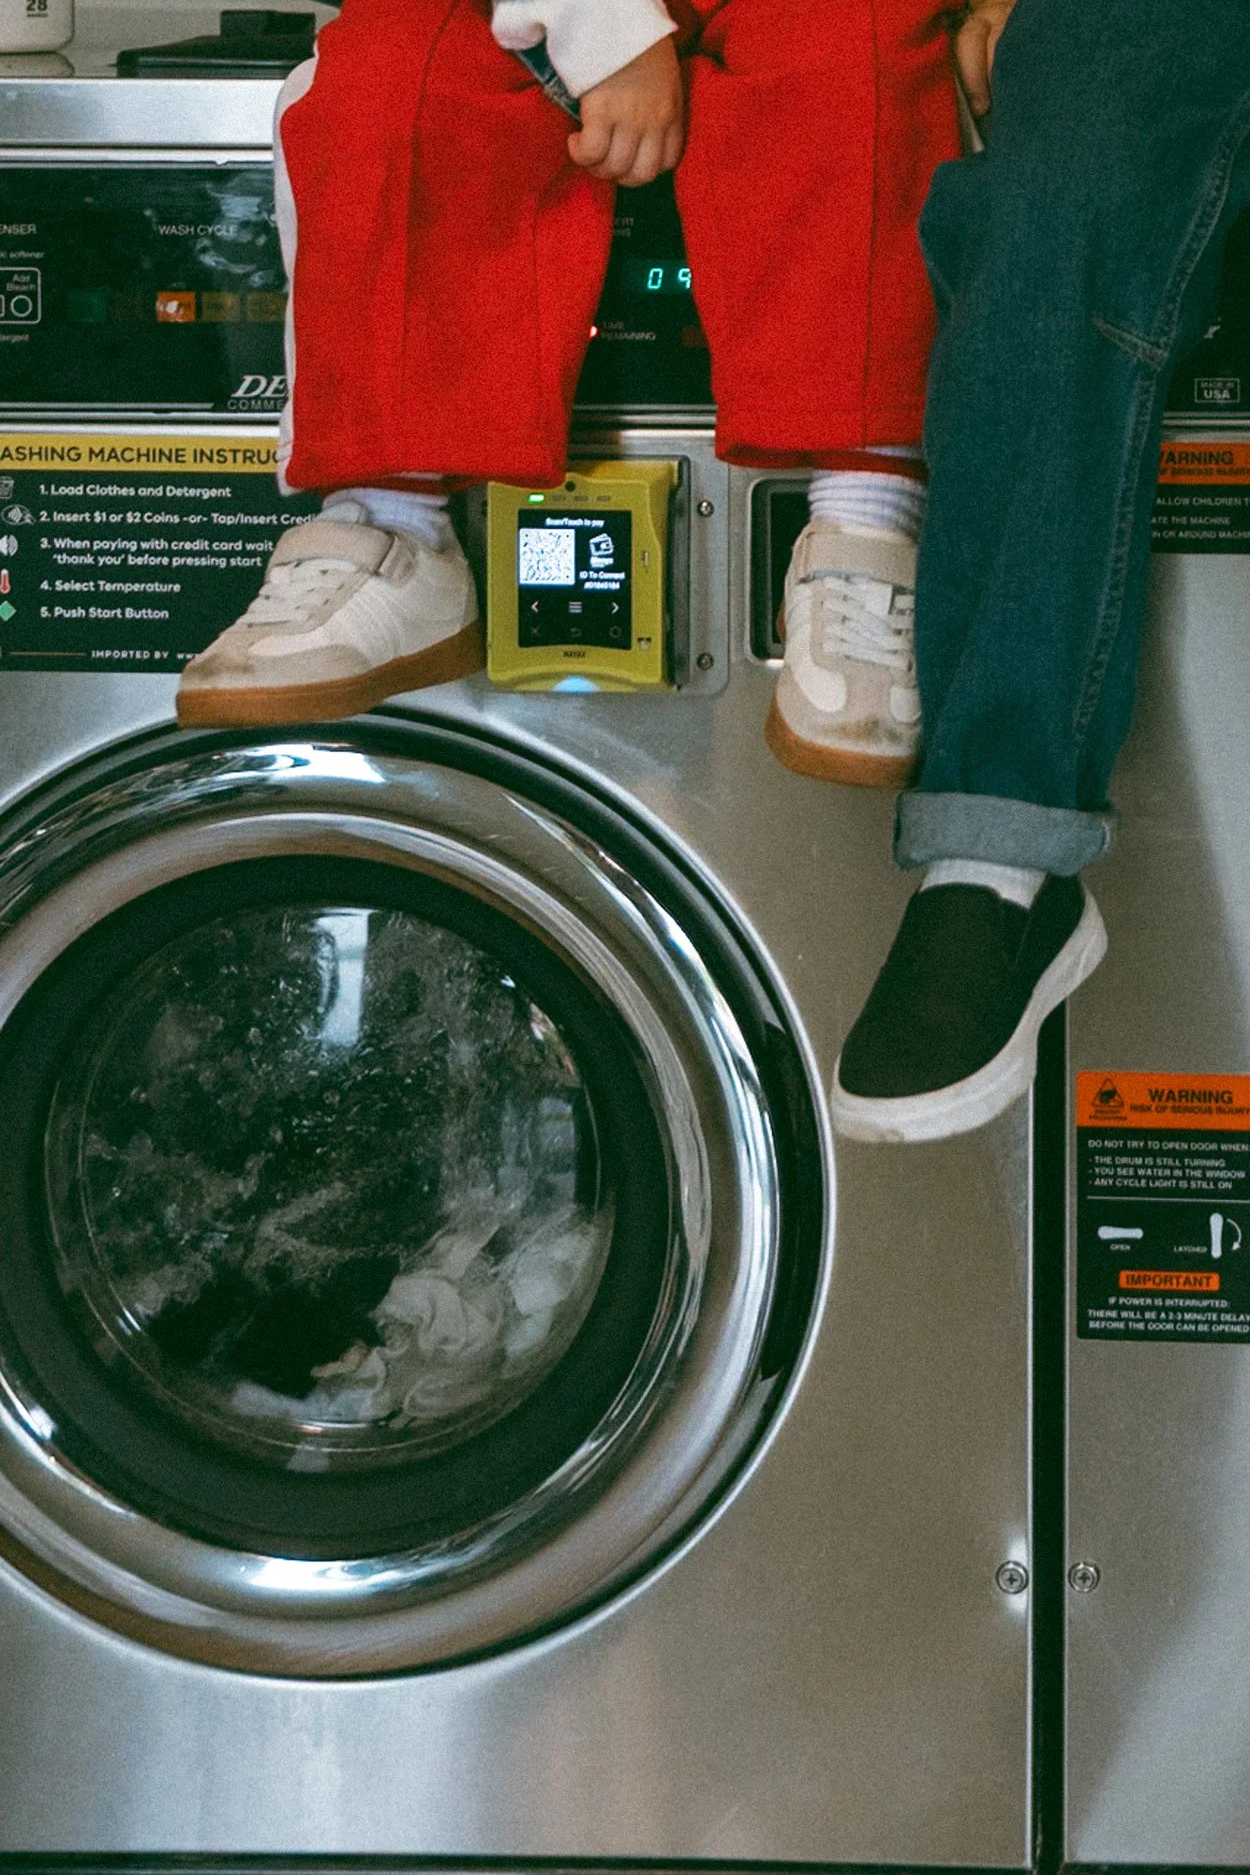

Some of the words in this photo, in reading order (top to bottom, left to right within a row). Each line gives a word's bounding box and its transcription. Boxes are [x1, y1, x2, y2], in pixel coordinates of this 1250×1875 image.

[159, 224, 195, 236] WASH
[1203, 388, 1231, 401] USA
[88, 447, 186, 464] MACHINE
[1159, 450, 1234, 466] ARNING
[39, 485, 48, 496] 1.
[51, 485, 84, 496] Load
[86, 485, 135, 497] Clothes
[138, 486, 163, 497] and
[166, 486, 232, 500] Detergent
[1156, 496, 1190, 507] ALLOW
[1192, 497, 1242, 507] CHILDREN
[39, 511, 50, 522] 2.
[53, 511, 91, 523] Insert
[93, 511, 107, 524] $1
[109, 514, 124, 524] or
[125, 511, 141, 524] $2
[144, 512, 180, 524] Coins
[211, 512, 277, 526] Tap/Insert
[1171, 516, 1188, 525] THE
[1189, 516, 1232, 526] MACHINE
[1178, 530, 1216, 540] AROUND
[40, 538, 51, 549] 3.
[53, 538, 91, 550] When
[92, 539, 138, 553] paying
[139, 538, 168, 551] with
[170, 538, 210, 551] credit
[212, 539, 243, 552] card
[245, 540, 274, 552] wait
[127, 554, 169, 567] before
[172, 557, 227, 570] pressing
[229, 555, 262, 568] start
[40, 580, 52, 592] 4.
[54, 580, 95, 593] Select
[98, 580, 182, 594] Temperature
[40, 607, 51, 618] 5.
[53, 607, 86, 619] Push
[88, 607, 123, 619] Start
[124, 608, 170, 620] Button
[91, 650, 150, 660] IMPORTED
[153, 650, 169, 660] BY
[1148, 1088, 1233, 1104] WARNING
[1087, 1139, 1103, 1148] DO
[1104, 1140, 1124, 1149] NOT
[1126, 1140, 1144, 1149] TRY
[1147, 1140, 1160, 1150] TO
[1162, 1141, 1188, 1150] OPEN
[1190, 1142, 1218, 1151] DOOR
[1094, 1156, 1112, 1165] THE
[1115, 1156, 1143, 1166] DRUM
[1144, 1157, 1153, 1166] IS
[1156, 1157, 1182, 1167] STILL
[1183, 1158, 1226, 1168] TURNING
[1094, 1167, 1114, 1176] YOU
[1116, 1167, 1135, 1176] SEE
[1137, 1168, 1171, 1177] WATER
[1172, 1168, 1183, 1177] IN
[1184, 1169, 1203, 1178] THE
[1205, 1169, 1246, 1179] WINDOW
[1094, 1178, 1114, 1187] ANY
[1115, 1178, 1148, 1188] CYCLE
[1149, 1179, 1178, 1188] LIGHT
[1179, 1180, 1188, 1189] IS
[1189, 1180, 1215, 1189] STILL
[1217, 1180, 1233, 1190] ON
[1125, 1275, 1213, 1287] IMPORTANT
[1108, 1296, 1118, 1305] IF
[1118, 1297, 1152, 1306] POWER
[1154, 1297, 1163, 1307] IS
[1087, 1309, 1118, 1318] THERE
[1120, 1309, 1143, 1319] WILL
[1144, 1310, 1157, 1319] BE
[1183, 1311, 1218, 1322] MINUTE
[1088, 1320, 1126, 1329] BEFORE
[1128, 1321, 1146, 1330] THE
[1147, 1321, 1175, 1331] DOOR
[1175, 1322, 1196, 1332] CAN
[1197, 1323, 1210, 1332] BE
[1212, 1323, 1250, 1333] OPENED
